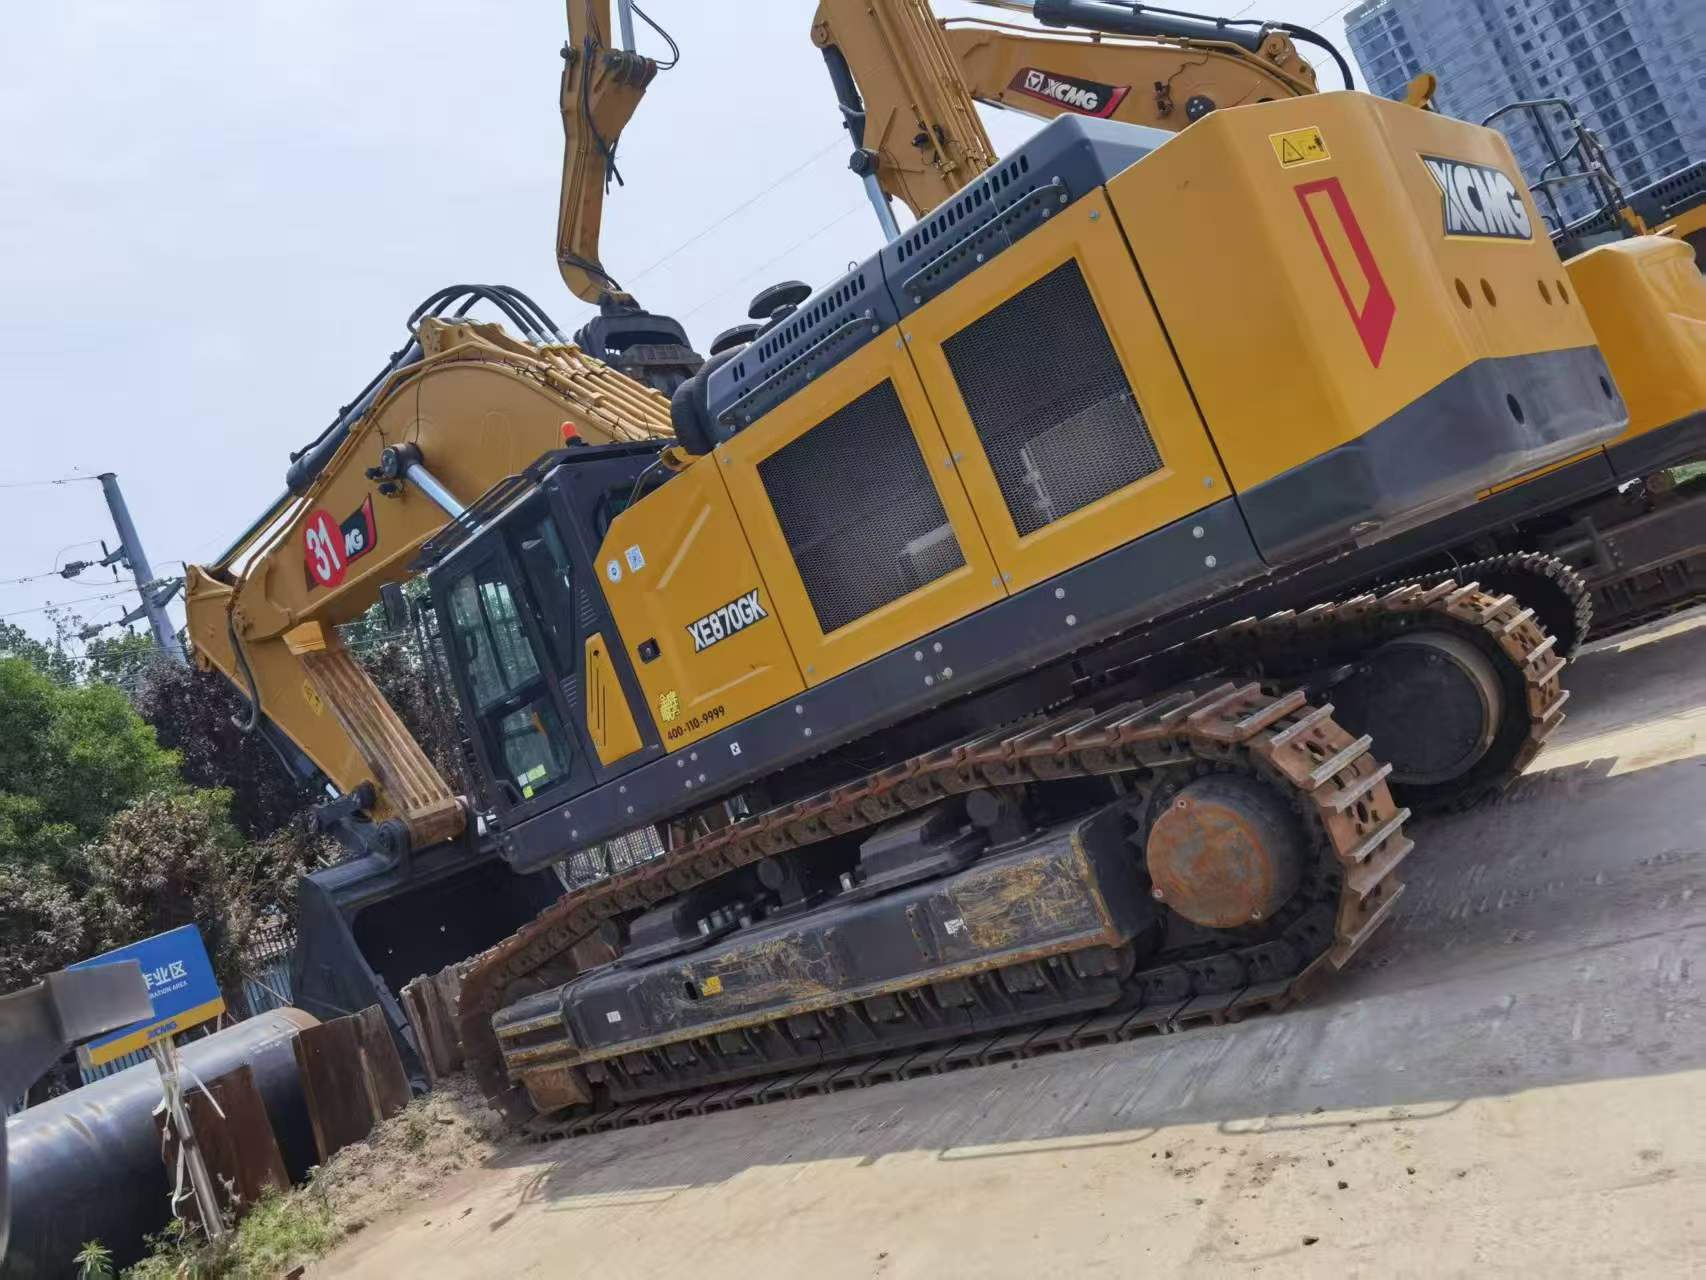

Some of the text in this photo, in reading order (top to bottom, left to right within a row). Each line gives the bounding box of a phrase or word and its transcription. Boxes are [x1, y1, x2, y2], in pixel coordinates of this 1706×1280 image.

[1042, 78, 1099, 111] XCMG
[1424, 159, 1532, 239] XCMG
[305, 516, 341, 582] 31
[687, 588, 769, 652] XE870GK
[667, 704, 725, 740] 400-110-9999
